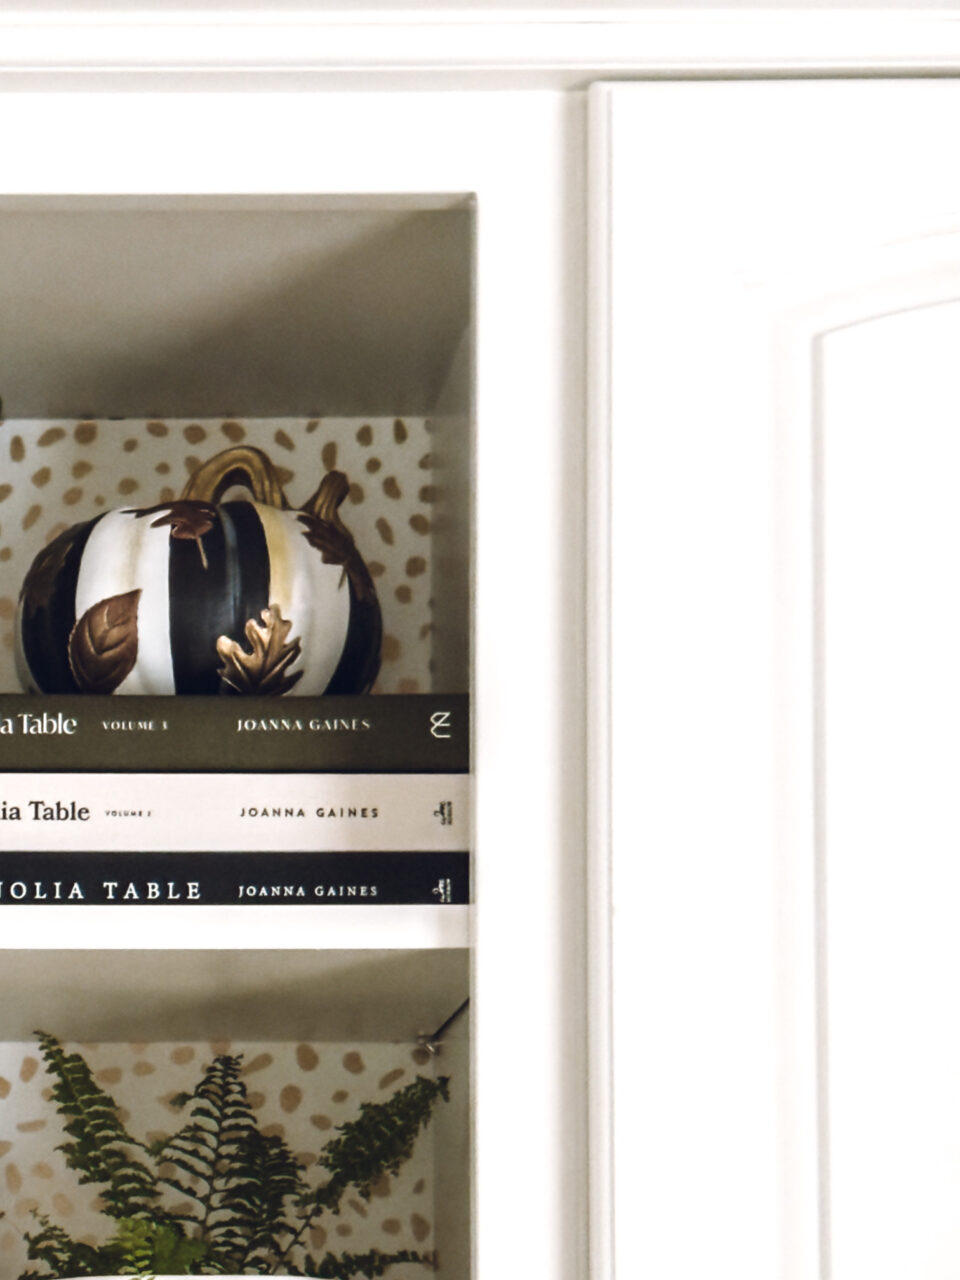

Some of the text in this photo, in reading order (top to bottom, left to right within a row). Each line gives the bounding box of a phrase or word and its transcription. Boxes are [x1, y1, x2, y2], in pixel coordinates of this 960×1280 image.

[17, 712, 78, 735] Table
[102, 720, 154, 731] VOLUME
[237, 719, 303, 733] JOANNA
[308, 719, 371, 731] GAINES
[28, 799, 90, 822] Table
[105, 809, 143, 818] VOLUME
[240, 807, 306, 819] JOANNA
[315, 807, 379, 819] GAINES
[102, 881, 201, 900] TABLE
[238, 885, 305, 898] JOANNA
[314, 885, 378, 898] GAINES
